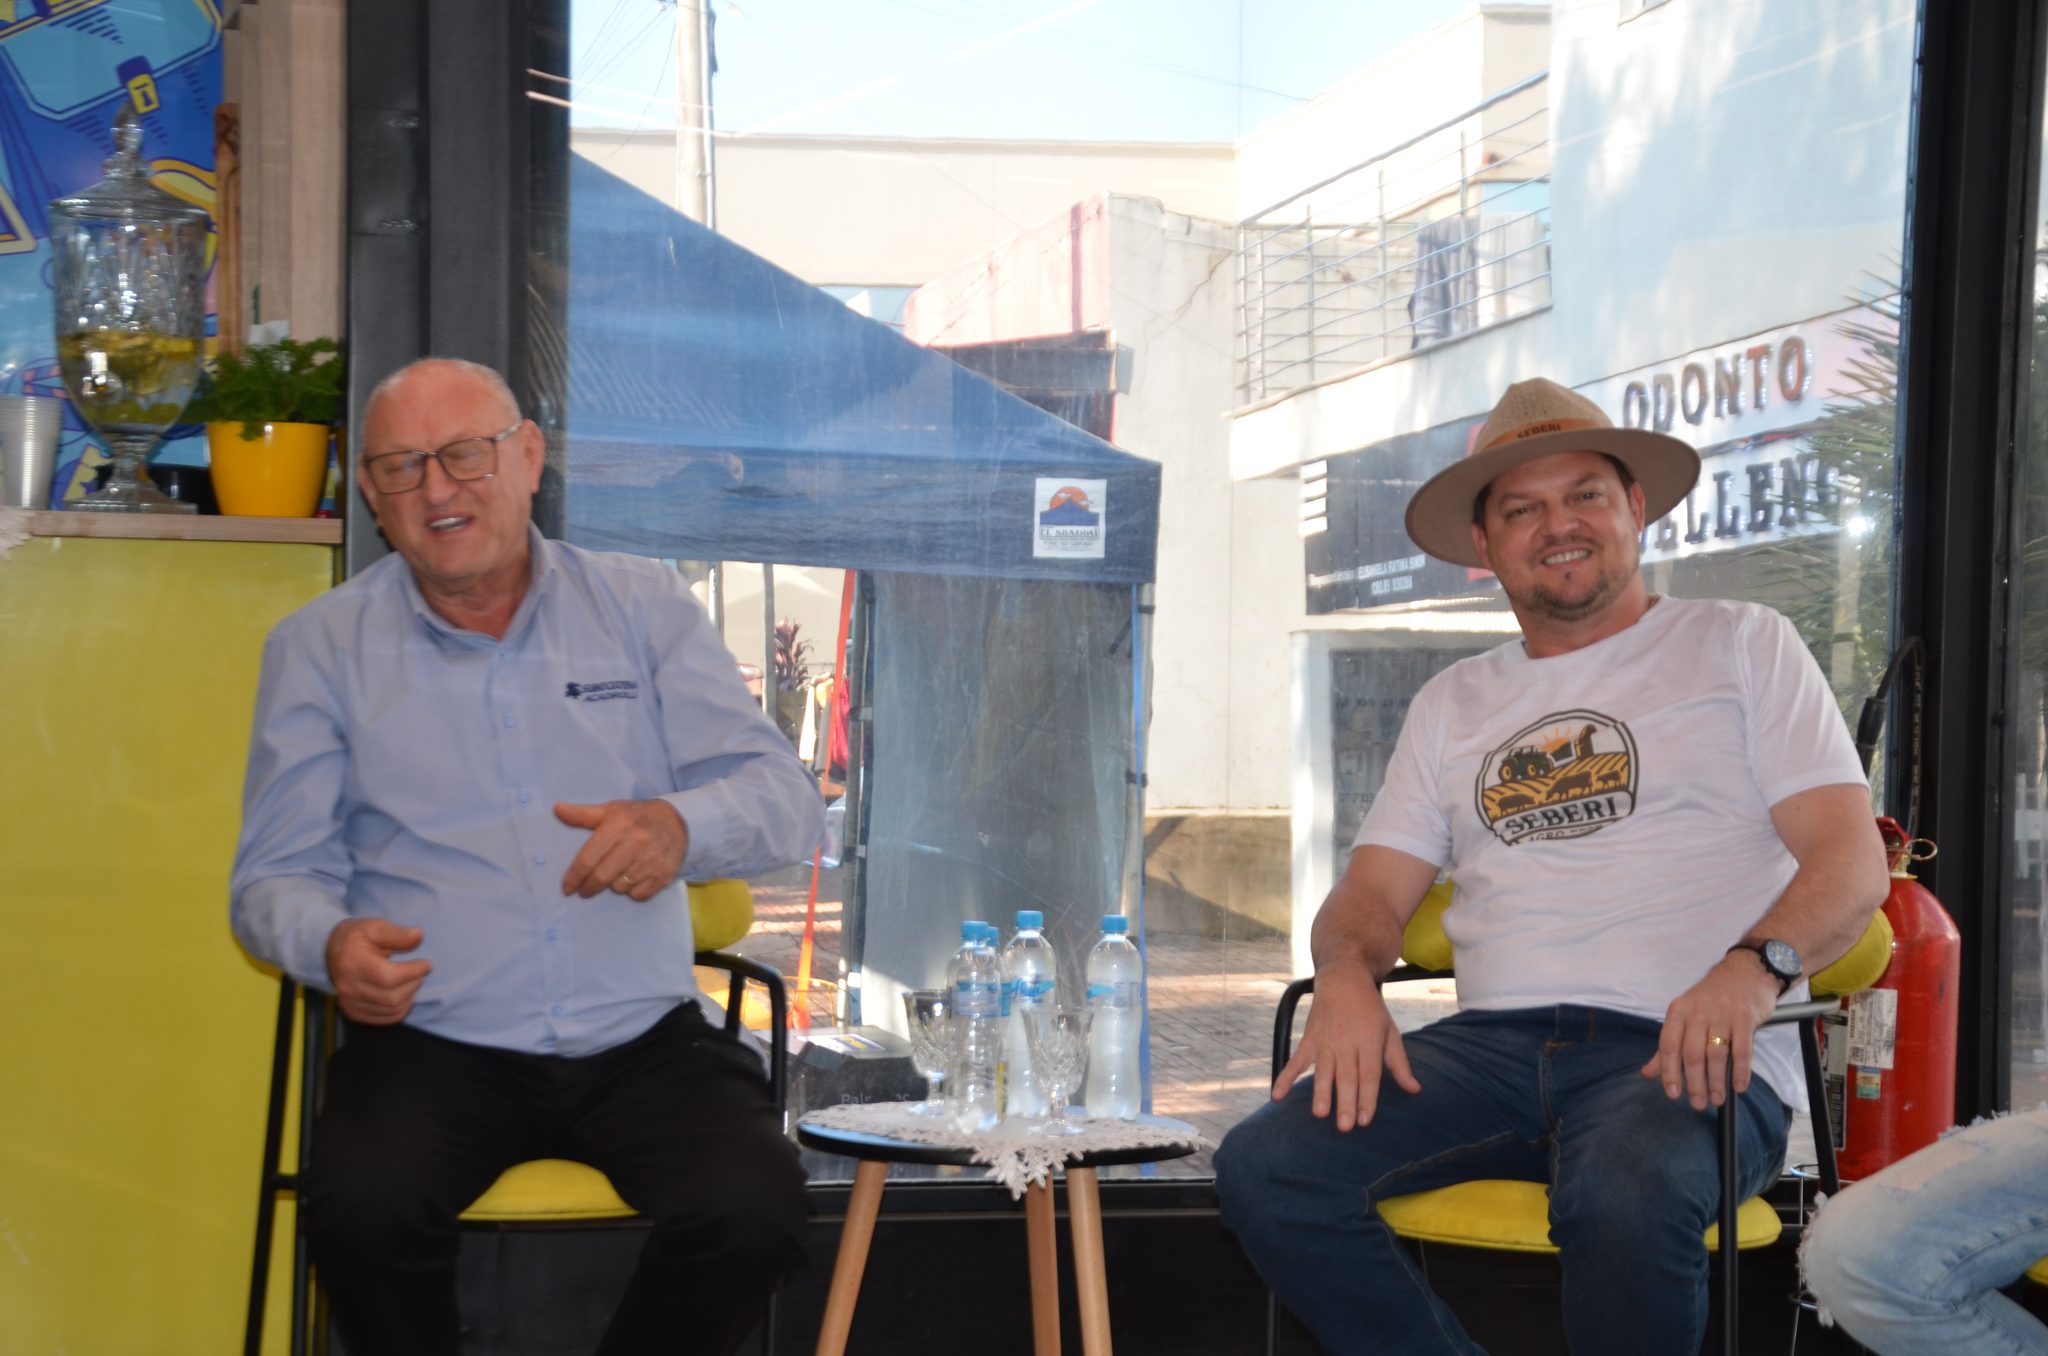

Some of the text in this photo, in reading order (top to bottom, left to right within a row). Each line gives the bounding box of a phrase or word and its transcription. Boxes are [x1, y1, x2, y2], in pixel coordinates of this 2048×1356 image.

[1623, 336, 1808, 432] ODONTO
[1517, 423, 1561, 438] SEBERI
[1505, 796, 1617, 835] SEBERI
